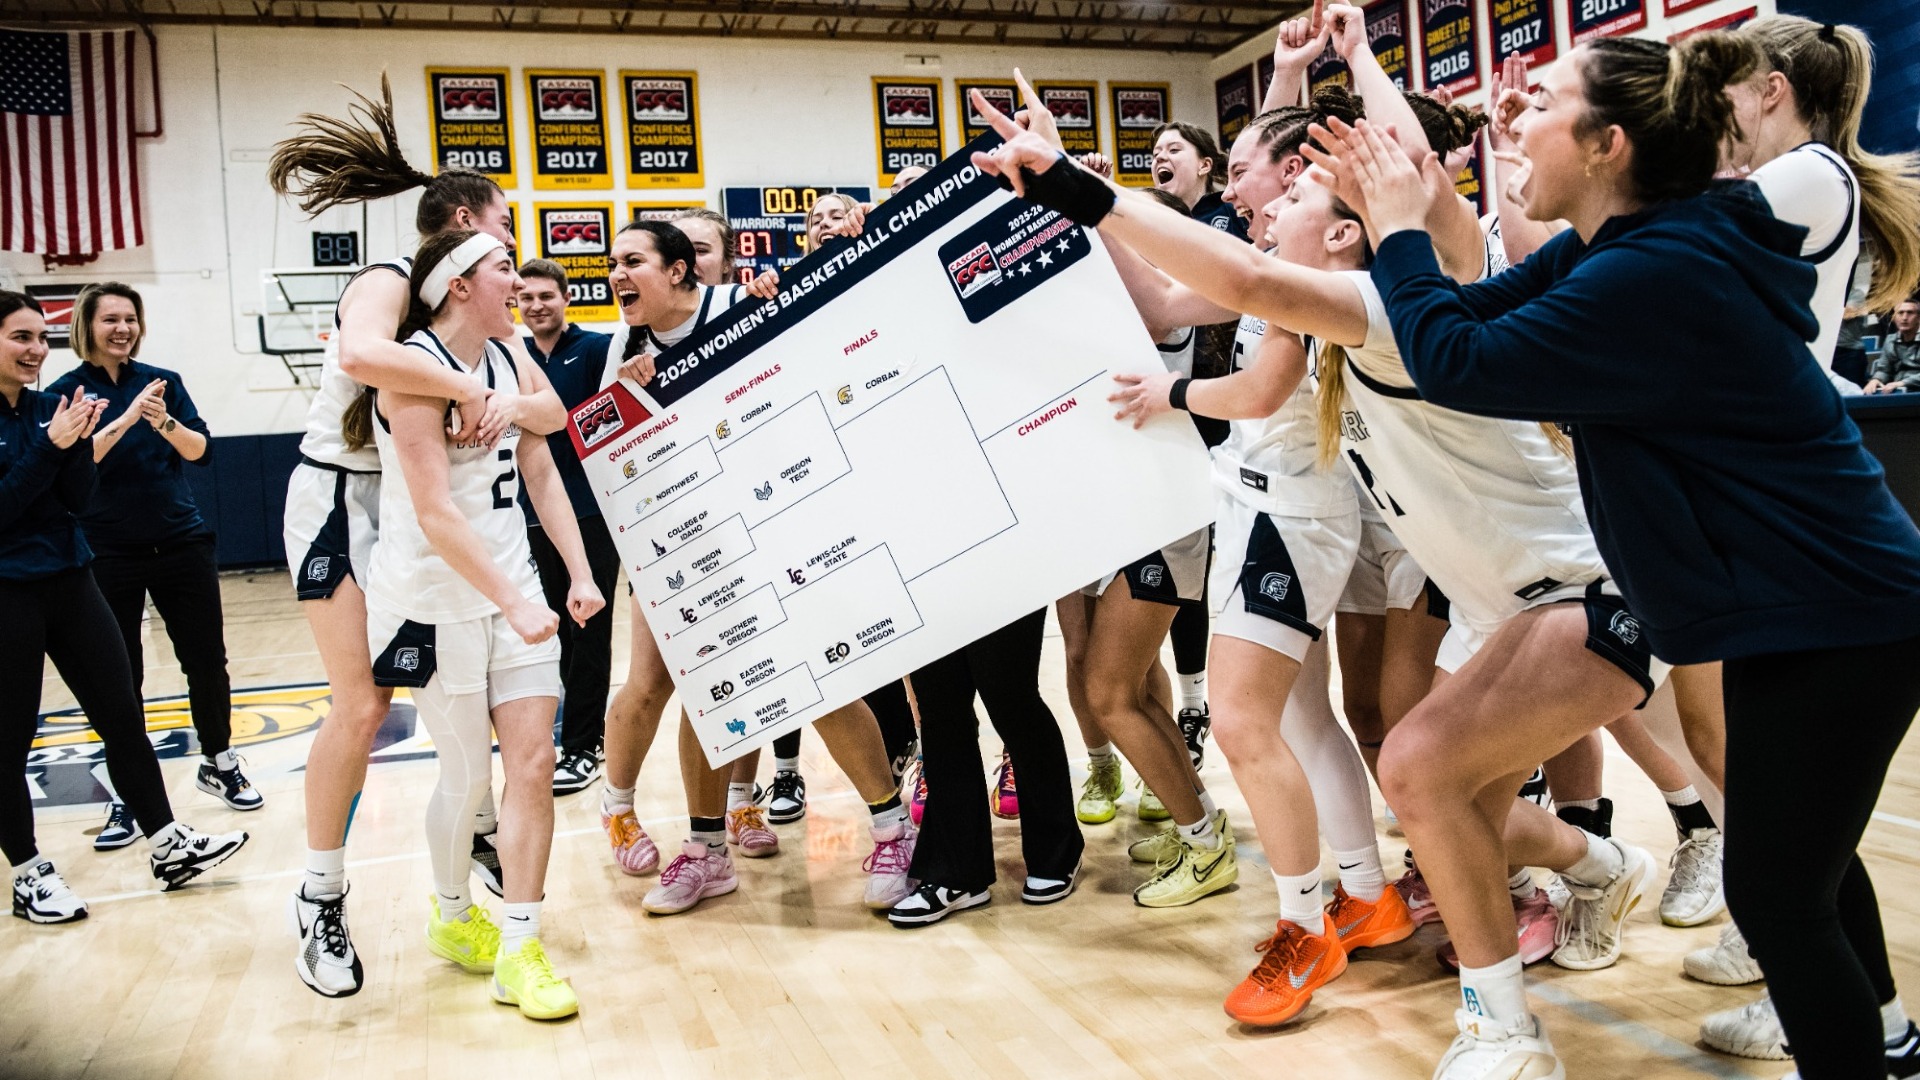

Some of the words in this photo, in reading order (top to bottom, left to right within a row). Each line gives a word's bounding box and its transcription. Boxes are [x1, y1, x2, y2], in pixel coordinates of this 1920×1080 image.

[1500, 19, 1542, 53] 2017
[1430, 50, 1470, 82] 2016
[440, 124, 504, 134] CONFERENCE
[539, 124, 600, 134] CONFERENCE
[633, 124, 691, 134] CONFERENCE
[441, 135, 506, 146] CHAMPIONS
[540, 135, 602, 146] CHAMPIONS
[634, 135, 693, 146] CHAMPIONS
[885, 139, 938, 148] CHAMPIONS
[447, 151, 502, 168] 2016
[547, 152, 598, 168] 2017
[640, 151, 688, 168] 2017
[888, 153, 936, 168] 2020
[1122, 154, 1152, 168] 202
[765, 189, 817, 214] 00.0
[730, 218, 786, 229] WARRIORS
[1008, 204, 1044, 231] 2025-26
[551, 224, 600, 240] CCC
[993, 228, 1027, 254] WOMEN'S
[740, 232, 772, 256] 87
[950, 244, 988, 271] CASCADE
[957, 253, 993, 284] CCC
[568, 283, 607, 301] 018
[657, 352, 700, 388] 2026
[698, 299, 780, 360] WOMEN'S
[779, 231, 890, 306] BASKETBALL
[843, 329, 879, 356] FINALS
[724, 363, 782, 404] SEMI-FINALS
[865, 369, 900, 391] CORBAN
[575, 394, 612, 421] CASCADE
[741, 400, 773, 423] CORBAN
[1017, 397, 1077, 437] CHAMPION
[580, 403, 614, 435] CCC
[608, 414, 679, 462] QUARTERFINALS
[647, 441, 677, 462] CORBAN
[780, 456, 812, 479] OREGON
[789, 468, 811, 485] TECH
[491, 449, 516, 509] 2
[655, 471, 699, 501] NORTHWEST
[618, 525, 625, 533] 8
[667, 514, 699, 539] COLLEGE
[698, 510, 709, 521] OF
[680, 524, 703, 542] IDAHO
[691, 548, 722, 570] OREGON
[806, 536, 858, 568] LEWIS-CLARK
[823, 551, 848, 569] STATE
[700, 559, 721, 576] TECH
[697, 576, 746, 608] LEWIS-CLARK
[713, 592, 737, 608] STATE
[650, 600, 657, 608] 5
[664, 632, 671, 640] 3
[718, 614, 759, 641] SOUTHERN
[726, 626, 758, 646] OREGON
[856, 617, 893, 640] EASTERN
[861, 627, 896, 648] OREGON
[739, 657, 774, 680] EASTERN
[744, 666, 777, 687] OREGON
[698, 709, 705, 717] 2
[754, 697, 787, 717] WARNER
[760, 706, 789, 726] PACIFIC
[713, 746, 720, 754] 7
